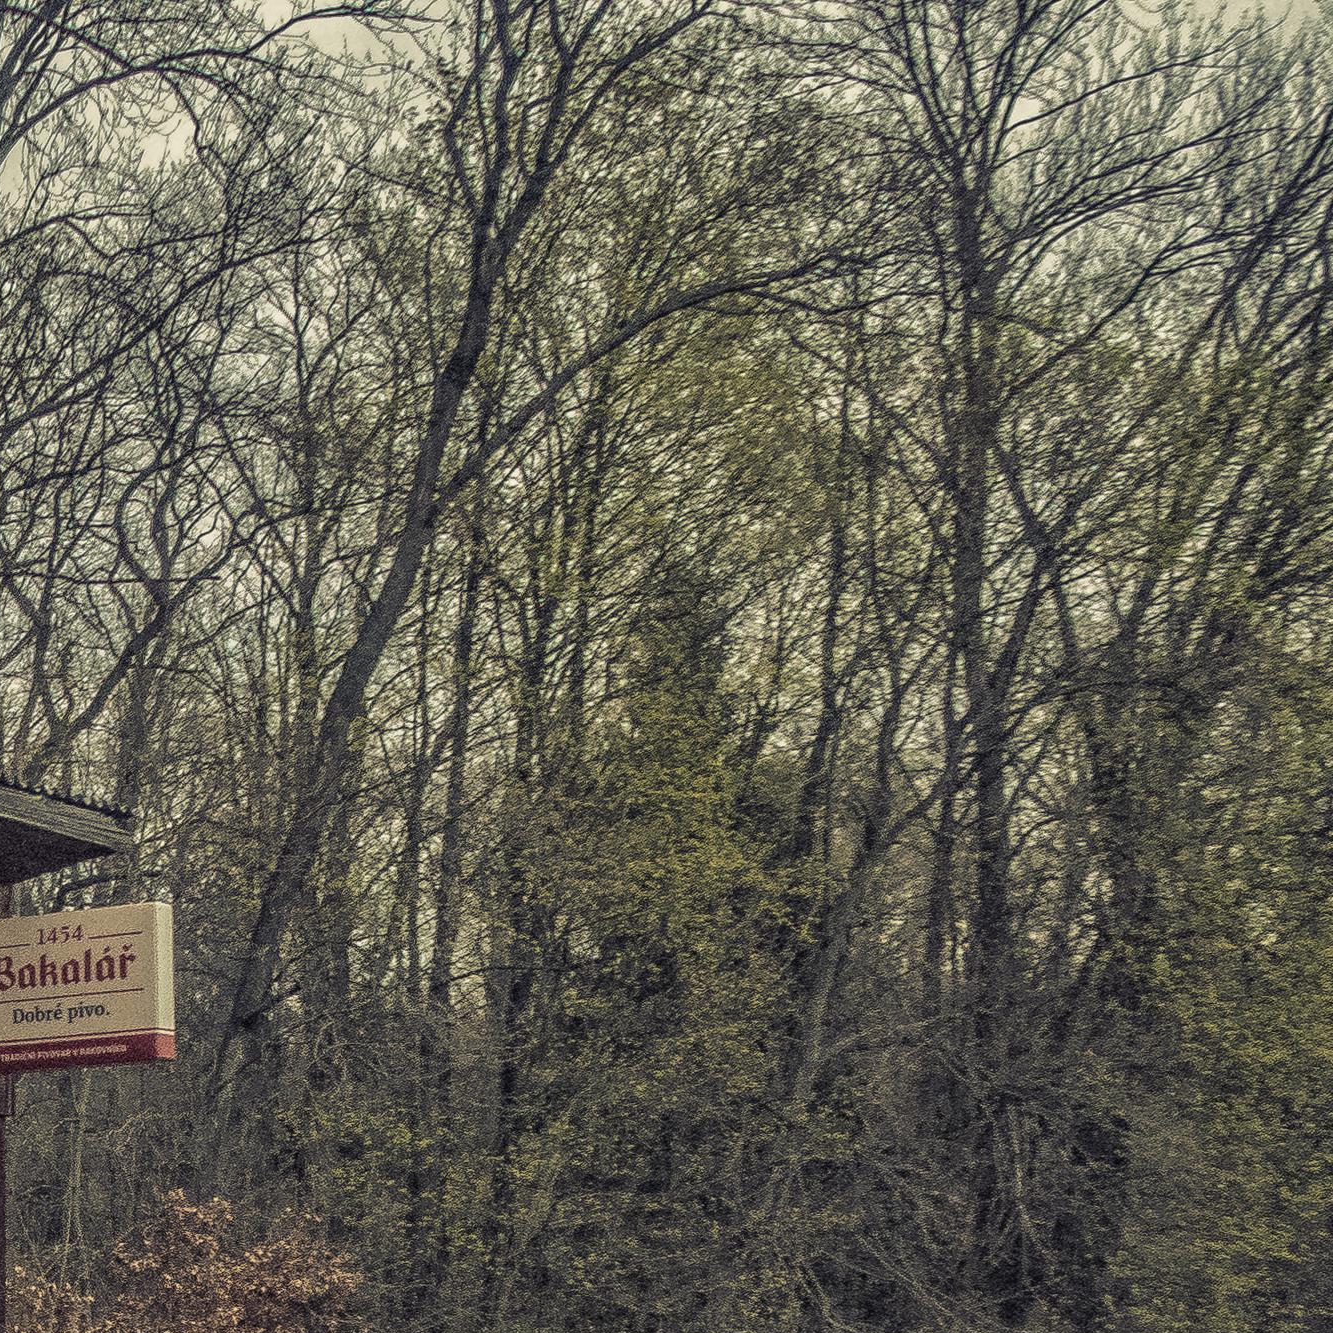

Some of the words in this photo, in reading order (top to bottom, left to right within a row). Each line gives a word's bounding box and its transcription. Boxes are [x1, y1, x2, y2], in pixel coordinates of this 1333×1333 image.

[37, 925, 83, 945] 1454
[12, 1002, 63, 1024] Dobré
[67, 1003, 110, 1022] pivo.
